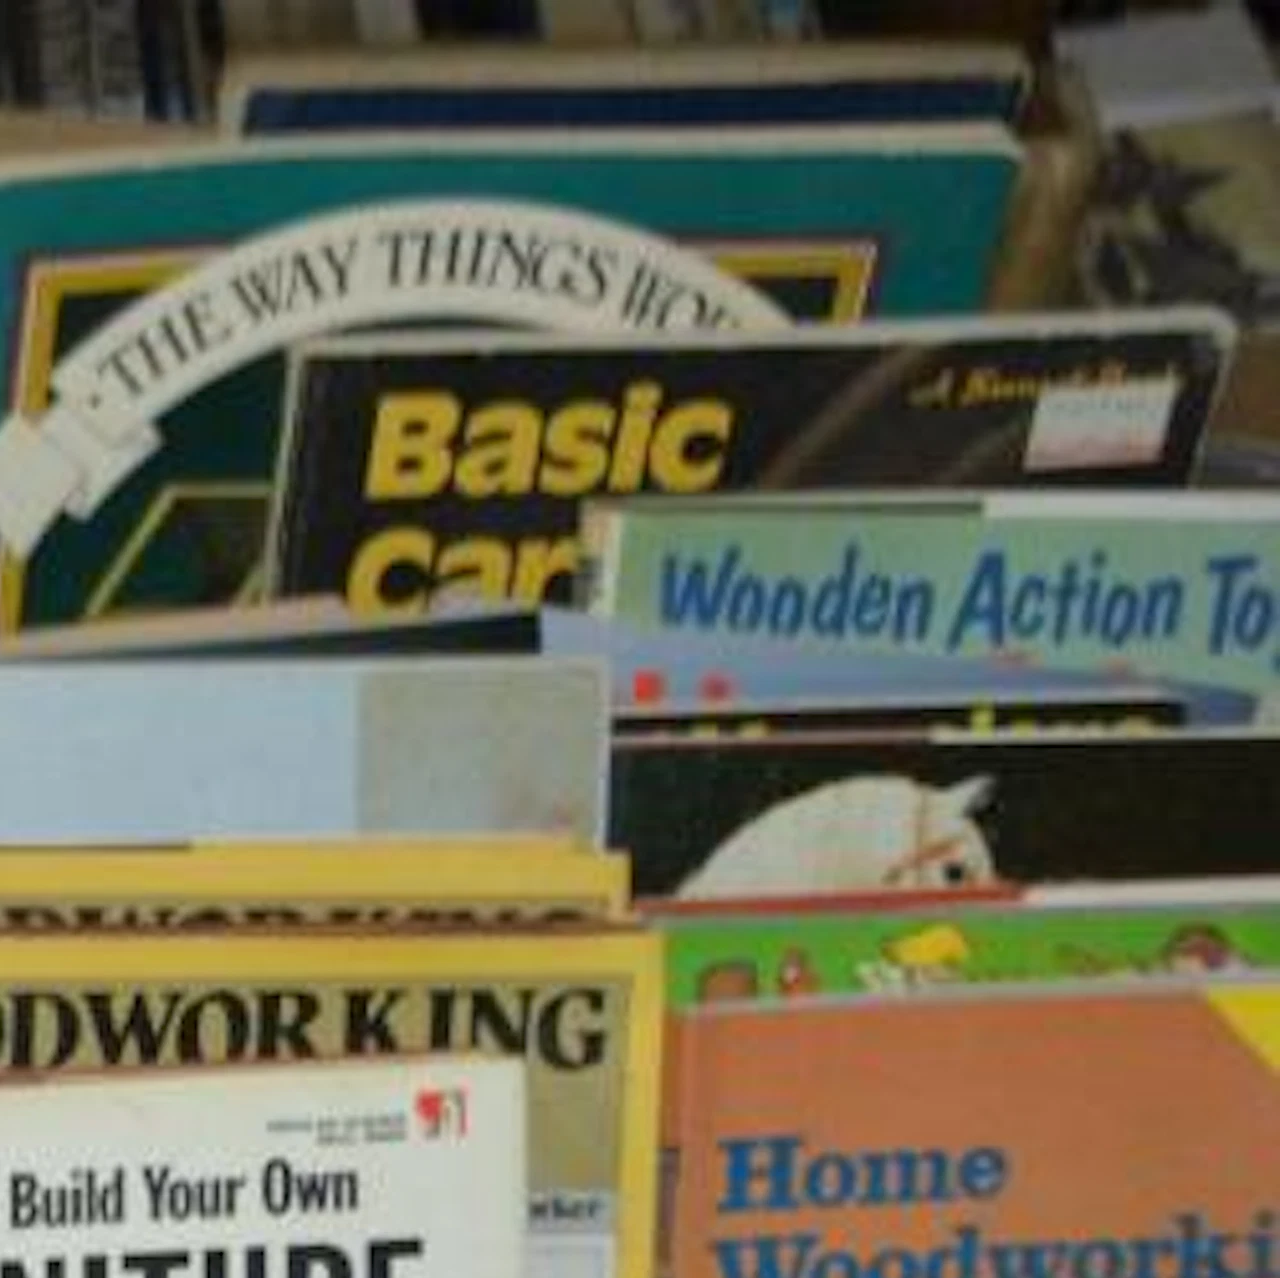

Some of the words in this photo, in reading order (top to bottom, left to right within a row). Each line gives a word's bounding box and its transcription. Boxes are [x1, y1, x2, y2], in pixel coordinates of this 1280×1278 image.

[97, 289, 235, 399] THE
[234, 237, 361, 322] WAY
[375, 227, 617, 303] THINGS
[365, 379, 734, 502] Basic
[659, 540, 935, 643] Wooden
[947, 548, 1186, 653] Action
[1204, 552, 1280, 672] To
[10, 1167, 125, 1230] Build
[143, 1165, 245, 1222] Your
[262, 1156, 359, 1217] Own
[715, 1135, 1009, 1213] Home
